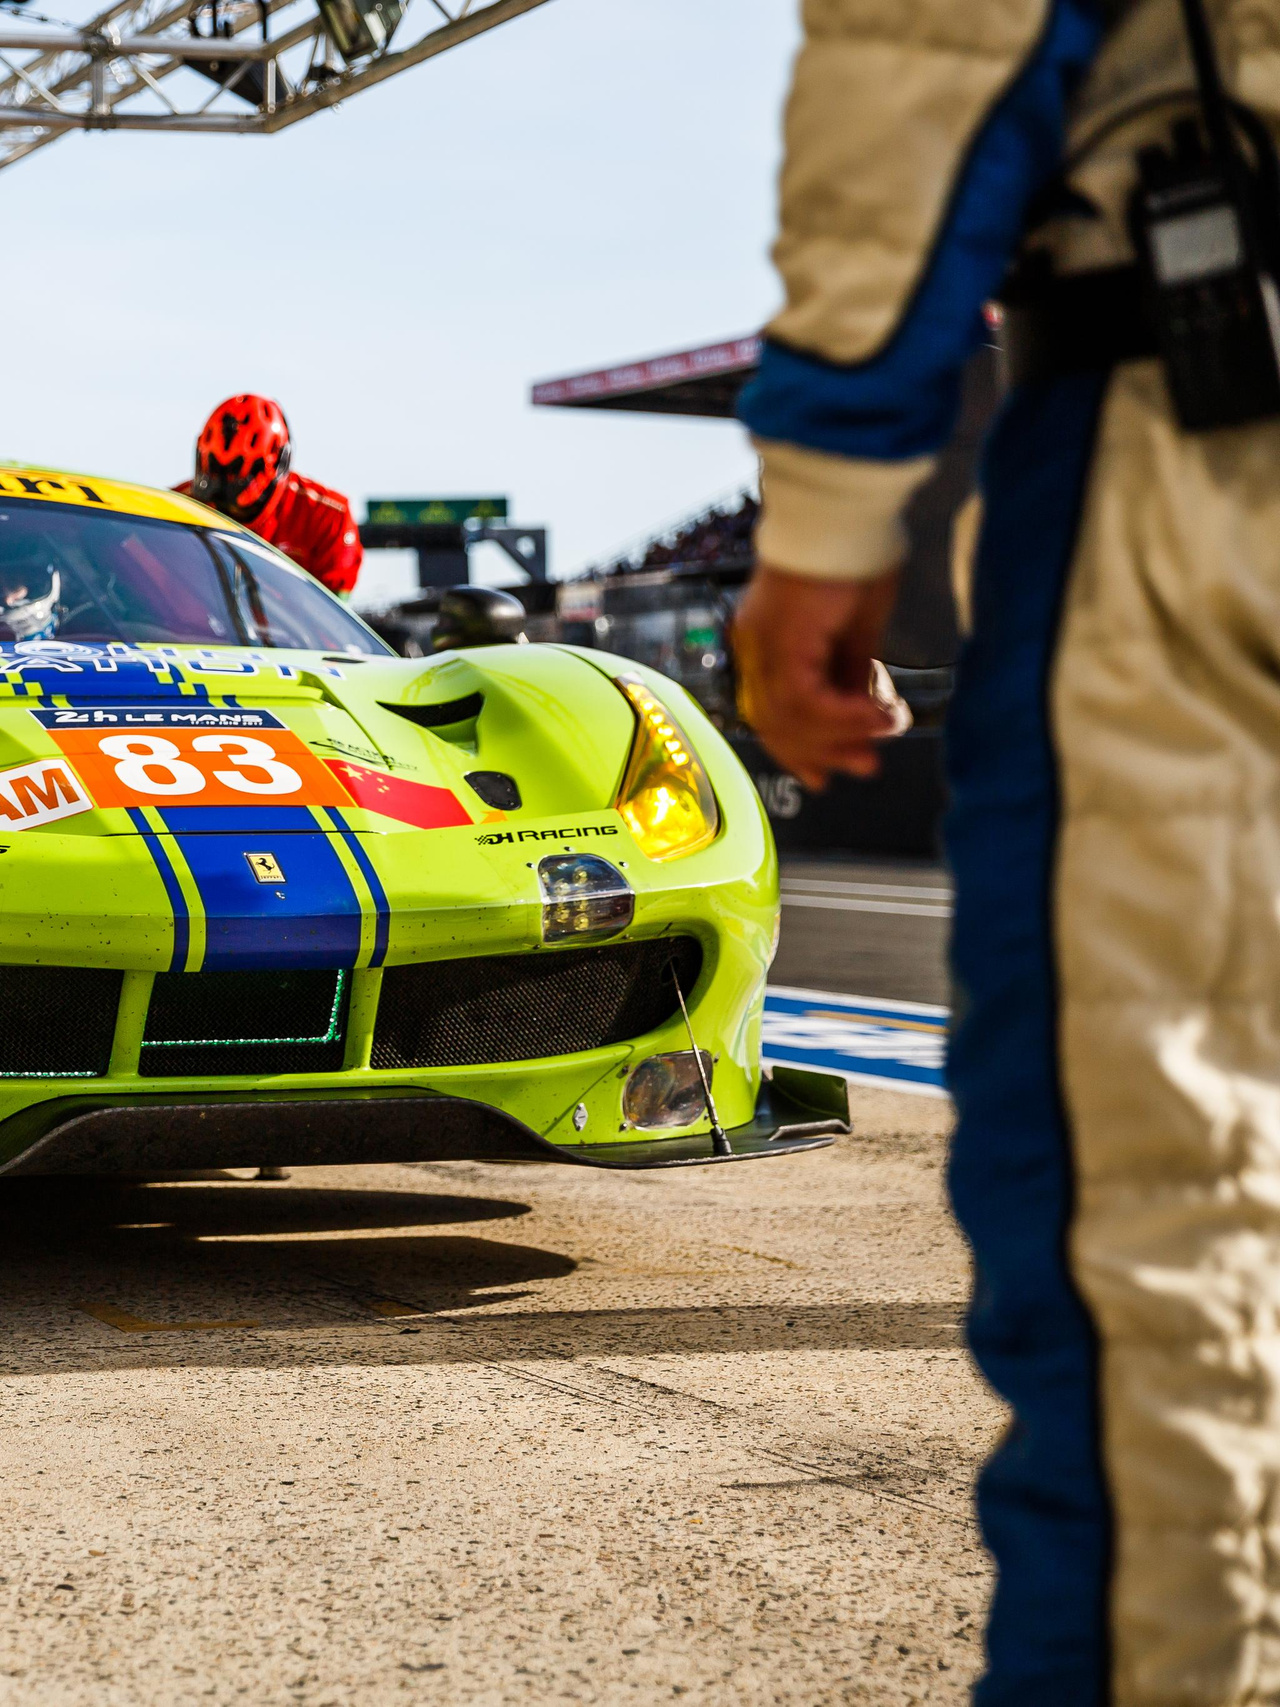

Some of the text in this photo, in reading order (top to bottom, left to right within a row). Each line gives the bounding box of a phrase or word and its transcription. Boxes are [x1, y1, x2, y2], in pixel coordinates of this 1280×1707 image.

[53, 710, 264, 724] 24h LE MANS
[98, 734, 304, 796] 83
[518, 825, 619, 844] RACING
